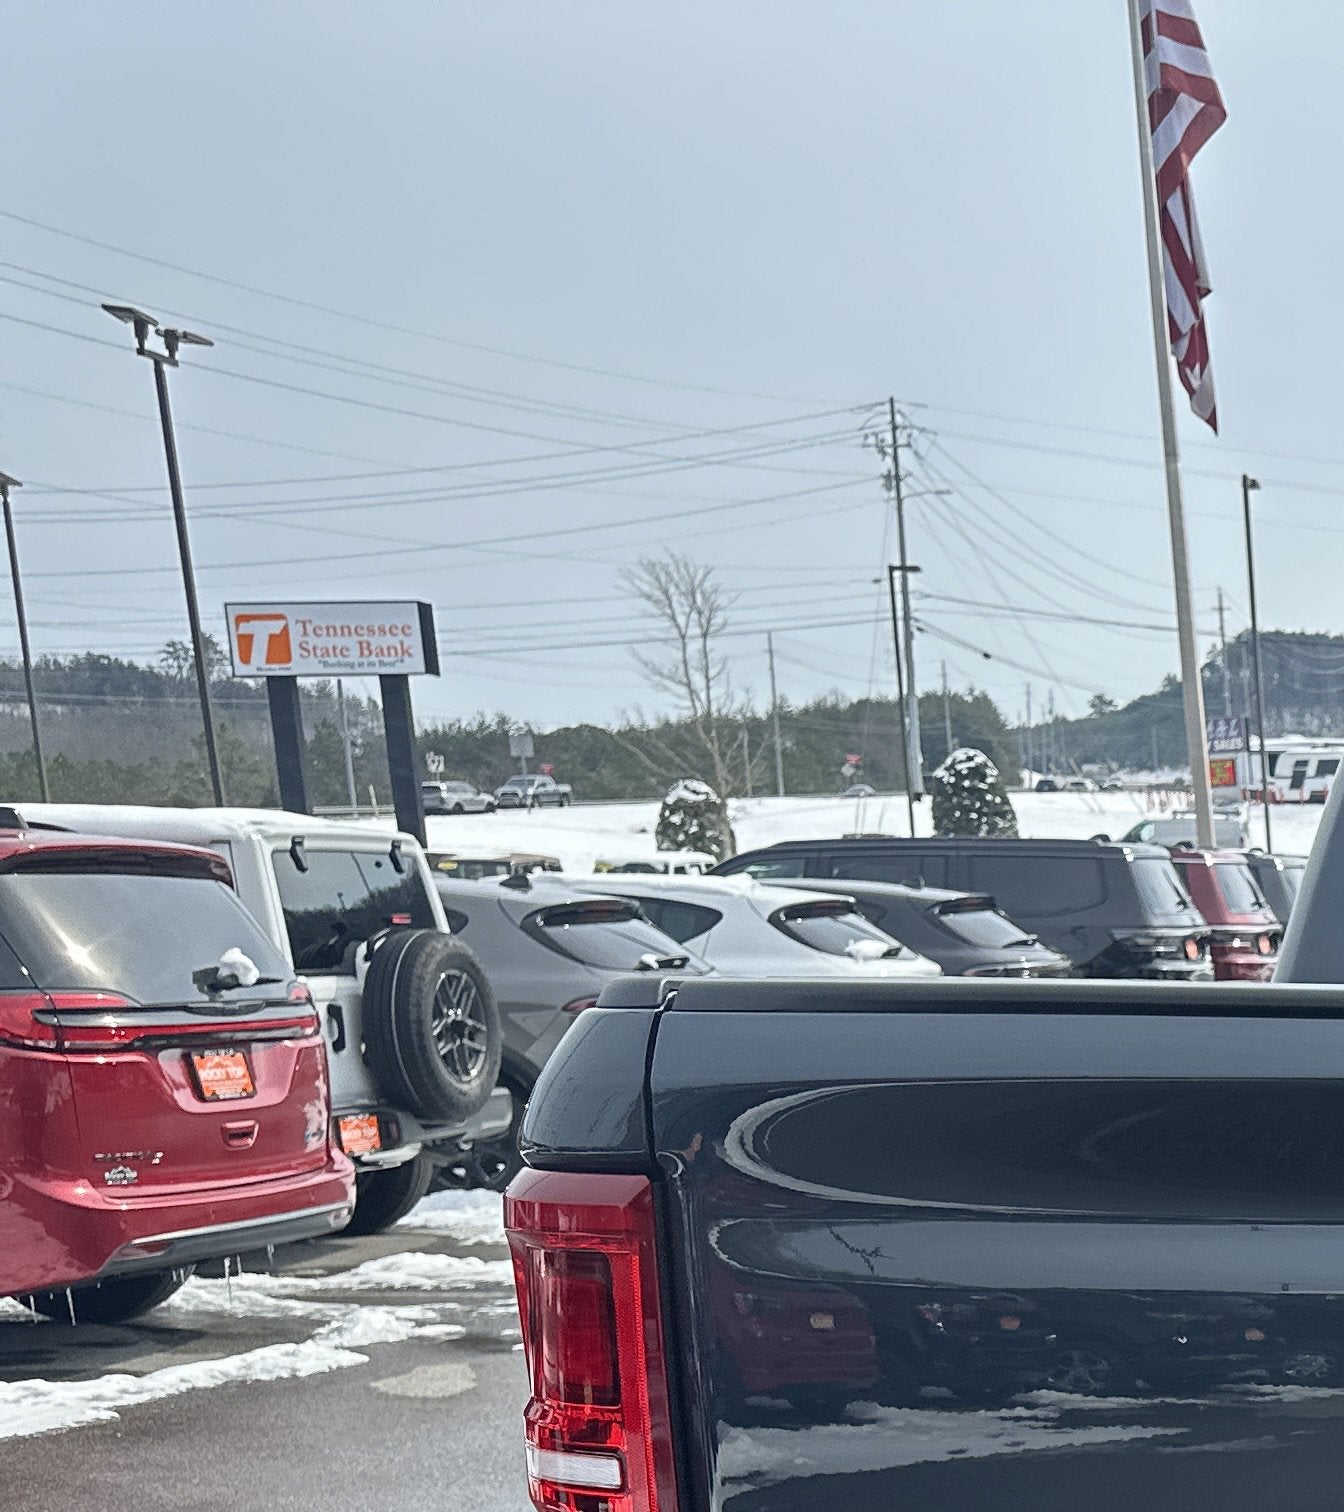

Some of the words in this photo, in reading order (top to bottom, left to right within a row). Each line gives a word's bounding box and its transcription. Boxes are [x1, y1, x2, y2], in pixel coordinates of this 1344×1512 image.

[296, 619, 413, 638] Tennessee
[298, 640, 350, 659] State
[357, 639, 413, 659] Bank
